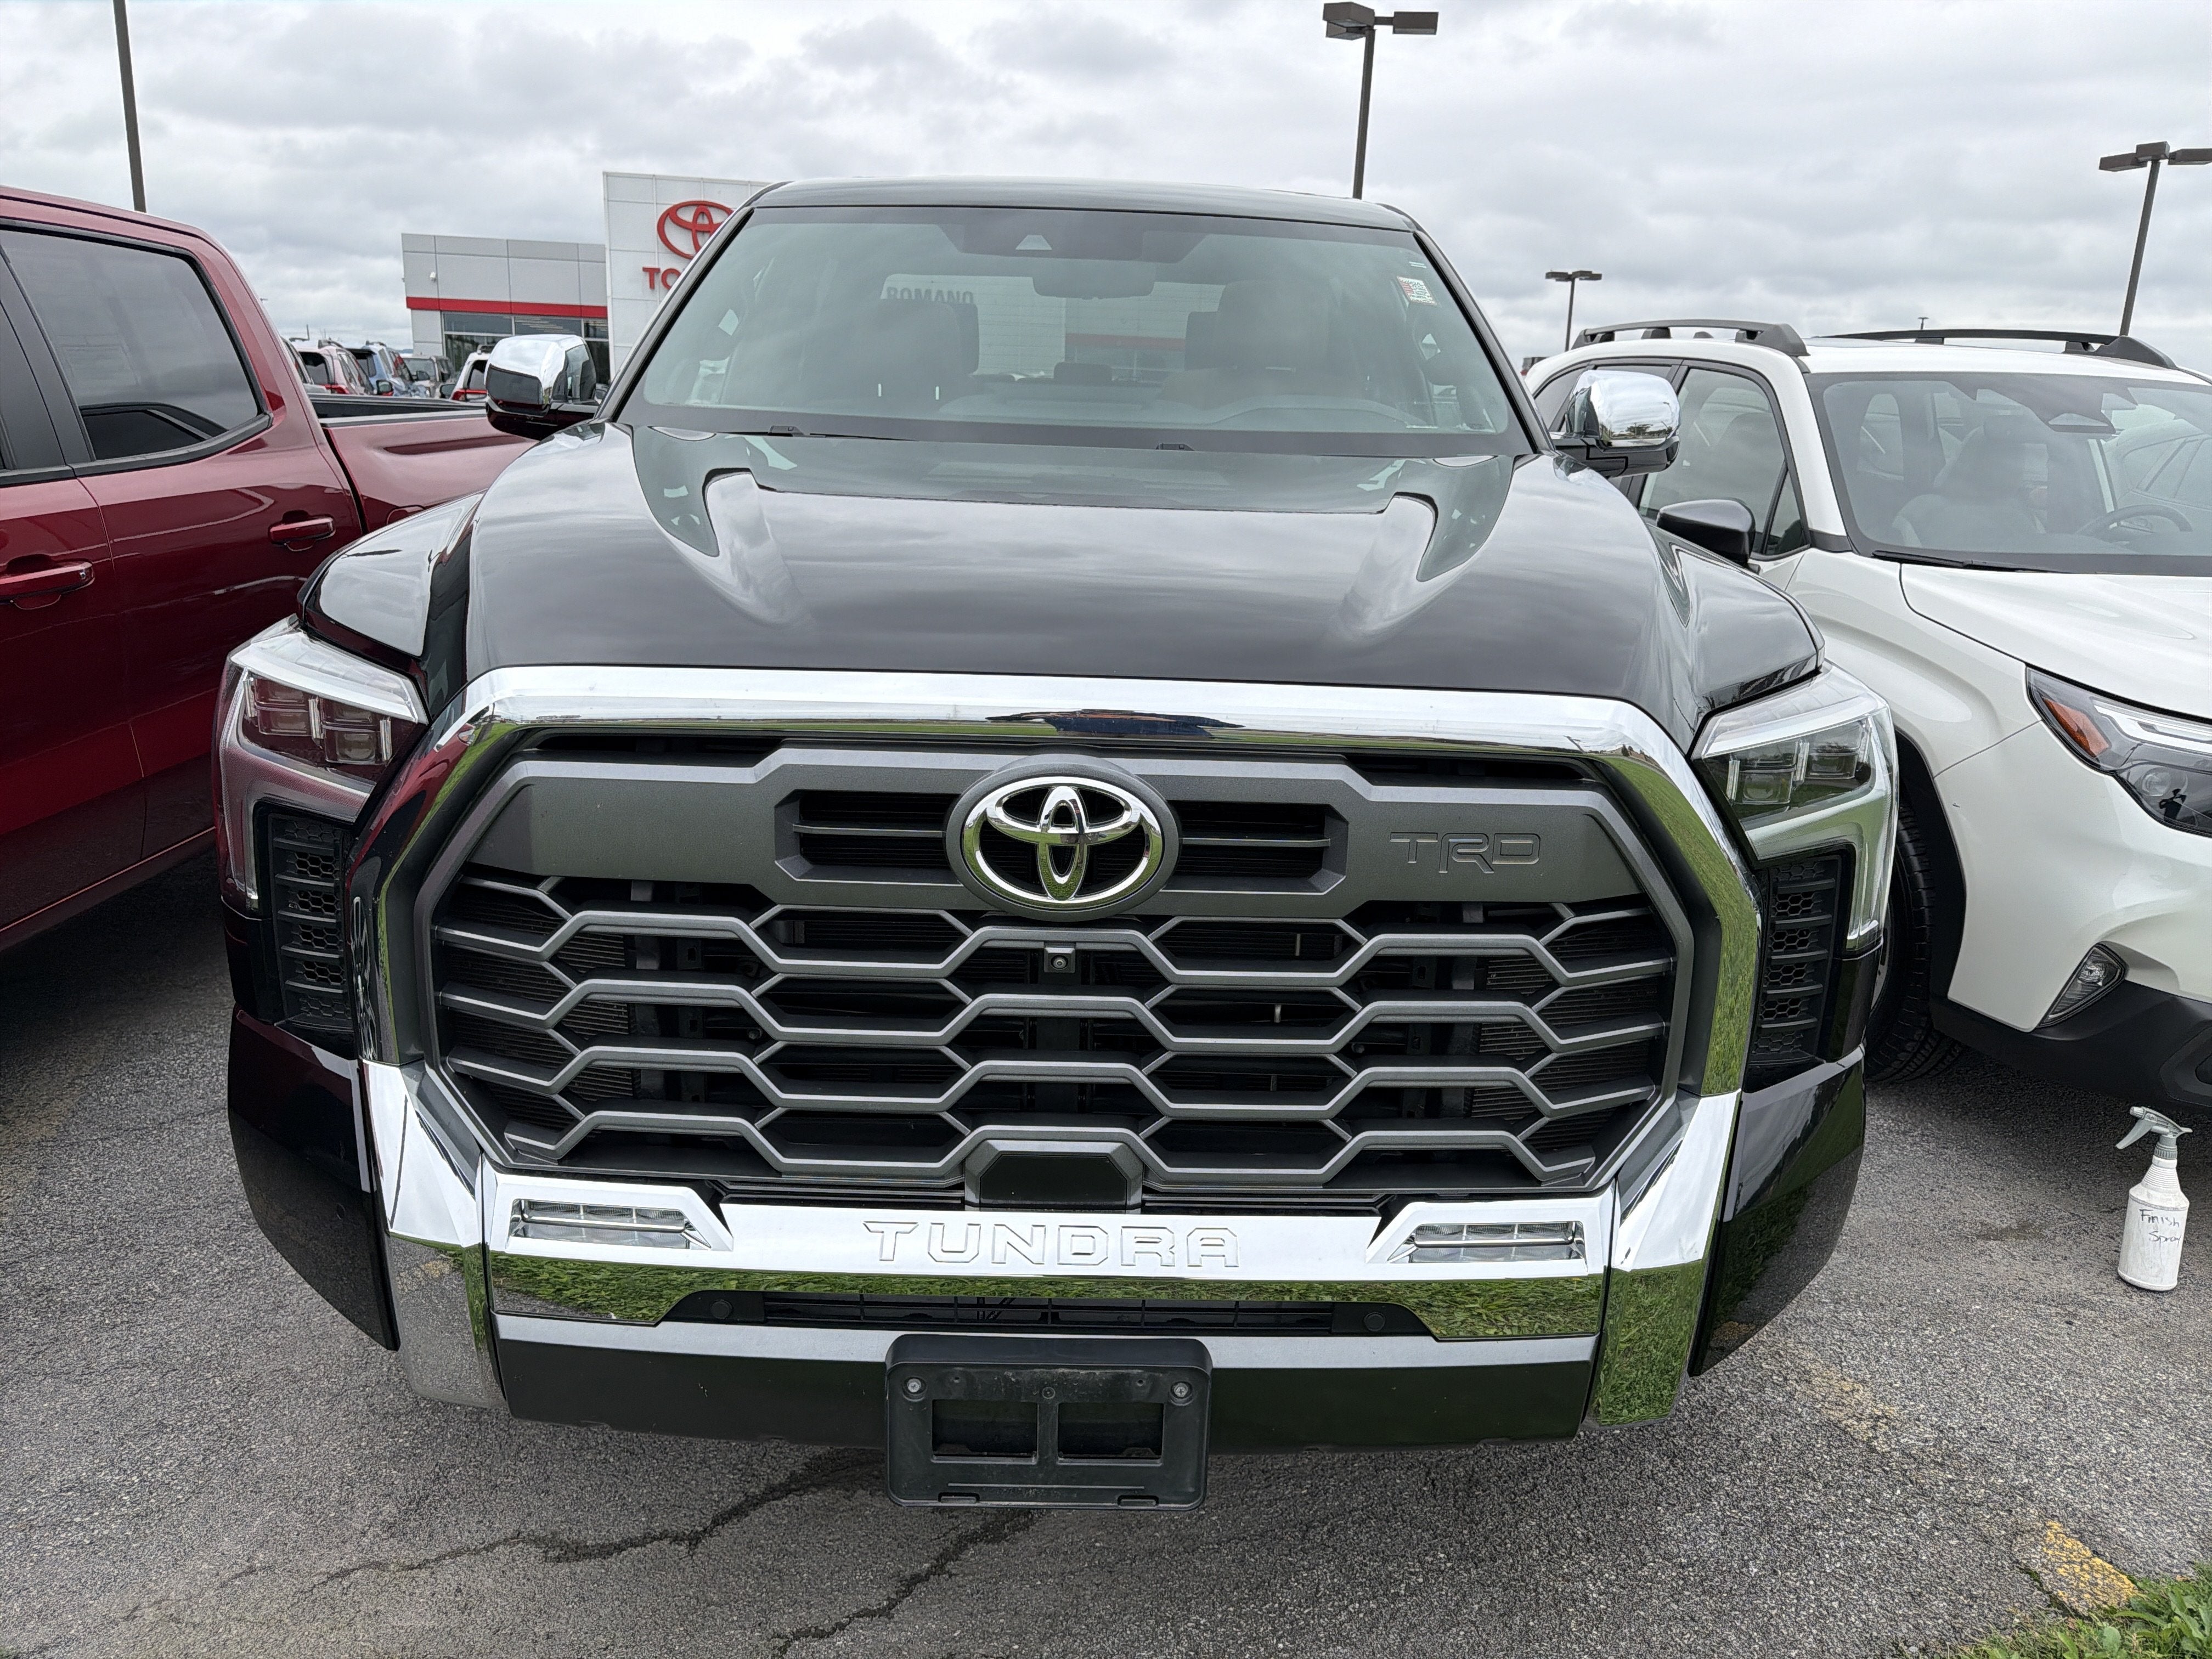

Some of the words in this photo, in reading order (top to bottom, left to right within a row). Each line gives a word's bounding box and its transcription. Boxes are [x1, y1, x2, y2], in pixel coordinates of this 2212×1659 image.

[1390, 832, 1541, 874] TRD
[2139, 1209, 2180, 1227] Finish
[862, 1221, 1240, 1268] TUNDRA
[2148, 1231, 2182, 1248] Spray
